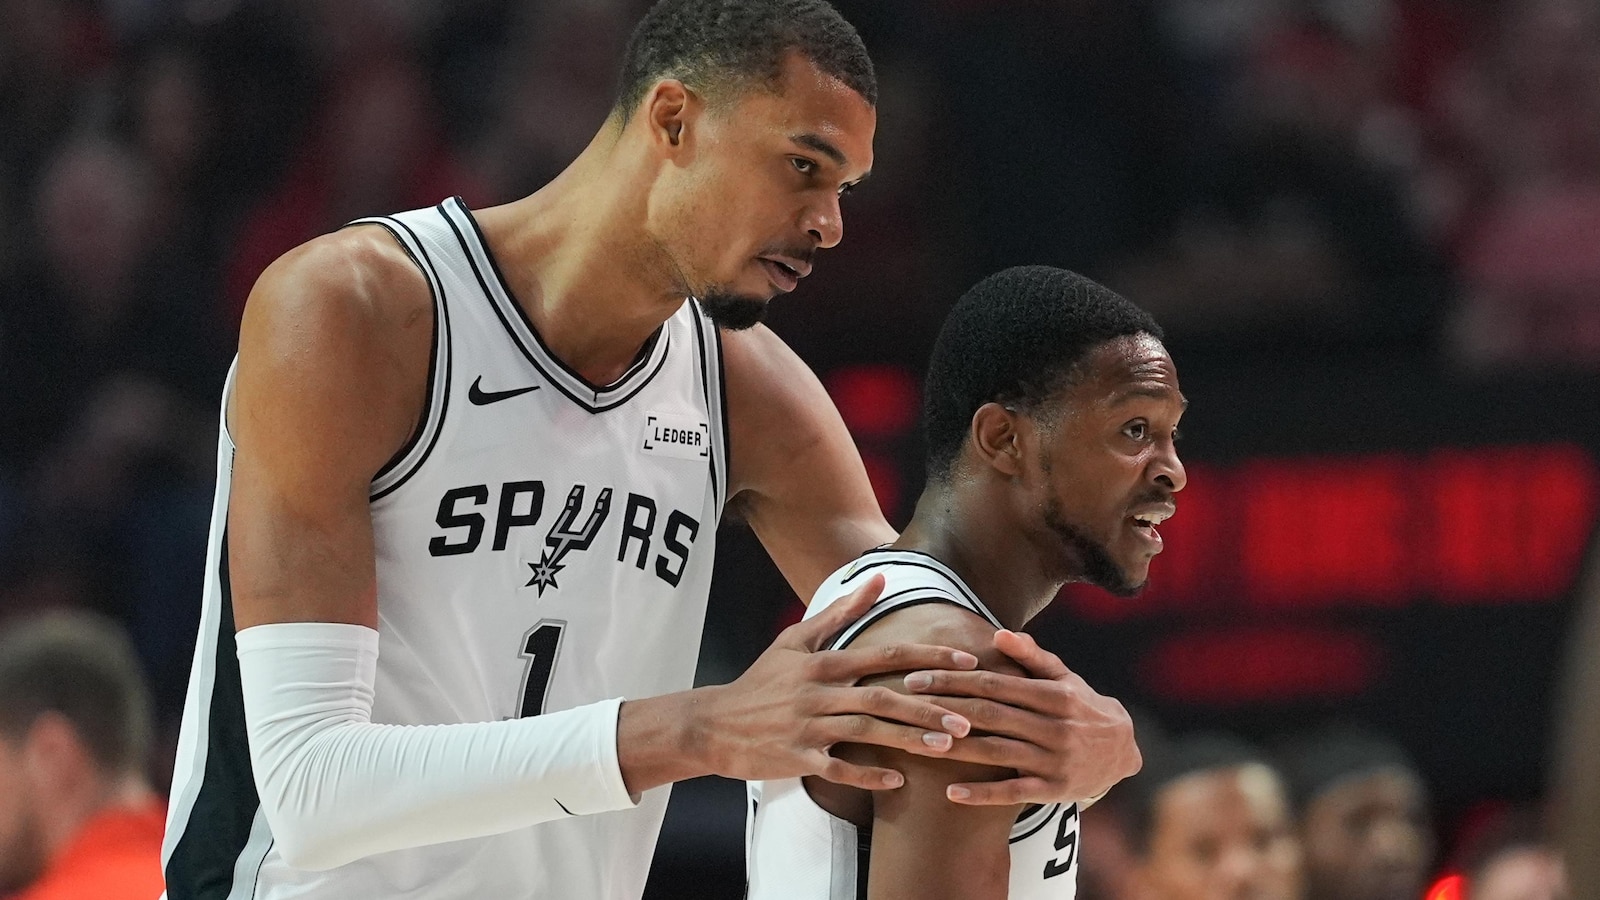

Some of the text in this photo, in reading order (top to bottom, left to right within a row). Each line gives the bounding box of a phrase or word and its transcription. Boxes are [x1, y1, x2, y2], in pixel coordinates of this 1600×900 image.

[654, 427, 701, 447] LEDGER
[428, 480, 700, 598] SPURS
[506, 618, 568, 720] 1
